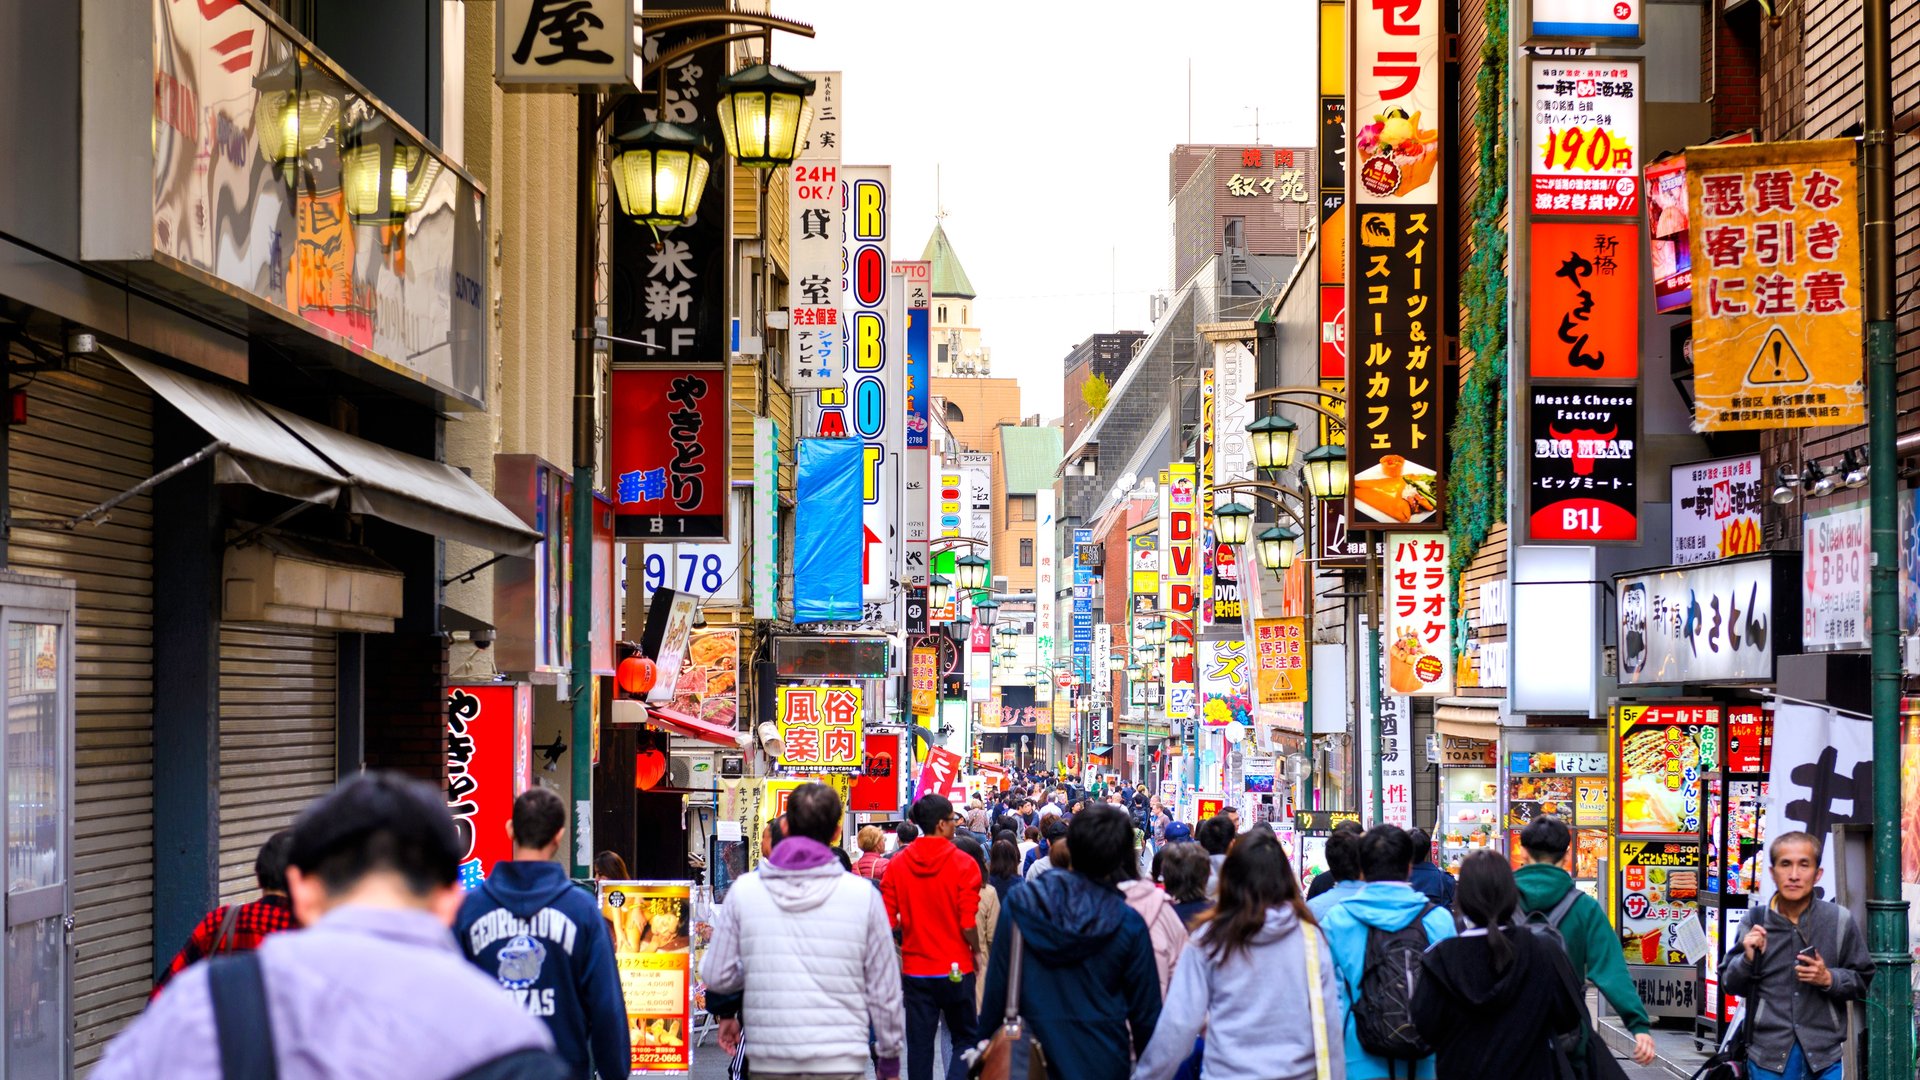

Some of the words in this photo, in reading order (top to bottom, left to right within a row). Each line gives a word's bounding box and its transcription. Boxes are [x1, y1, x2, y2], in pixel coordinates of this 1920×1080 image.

[1616, 6, 1629, 16] 3F
[511, 0, 615, 66] 屋
[1537, 79, 1633, 98] 一軒め酒場
[1242, 149, 1294, 168] 焼肉
[795, 166, 836, 182] 24H
[798, 186, 833, 200] OK!
[1227, 169, 1309, 202] 叙々苑
[1619, 182, 1632, 192] 2F
[1701, 168, 1842, 217] 悪質な
[1324, 197, 1342, 208] 4F
[1704, 219, 1841, 270] 客引き
[1593, 234, 1619, 276] 新橋
[1708, 270, 1848, 318] に注意
[794, 307, 837, 325] 完全個室
[1555, 251, 1604, 371] やきとん
[1405, 212, 1432, 449] スイーツ&ガレット
[641, 328, 696, 356] 1F
[854, 179, 886, 504] ROBOT
[1365, 254, 1392, 449] スコールカフェ
[798, 331, 812, 378] テレビ有
[817, 330, 832, 378] シャワー有
[1535, 395, 1569, 406] Meat
[1571, 395, 1581, 406] &
[1584, 395, 1633, 406] Cheese
[1557, 410, 1611, 422] Factory
[667, 374, 708, 511] やきとり
[1535, 440, 1573, 459] BIG
[1577, 440, 1633, 459] MEAT
[1562, 508, 1588, 530] B1
[1820, 522, 1844, 553] Steak
[1845, 515, 1862, 549] and
[912, 575, 925, 583] 2F
[1394, 540, 1418, 618] パセラ
[1422, 539, 1447, 643] カラオケ
[910, 608, 920, 616] 2F
[1684, 580, 1768, 659] やきとん
[907, 621, 926, 634] walk
[1259, 625, 1300, 639] 悪質な
[1805, 608, 1817, 638] B1
[1260, 641, 1300, 654] 客引き
[1261, 655, 1302, 670] に注意
[784, 690, 859, 726] 風俗
[1623, 709, 1638, 721] 5F
[1646, 709, 1719, 724] ゴールド館
[785, 728, 856, 763] 案内
[1445, 738, 1491, 750] ハニトー
[1445, 752, 1485, 761] TOAST
[1561, 757, 1601, 773] はしご
[1665, 726, 1681, 790] 食べ放題
[1579, 803, 1605, 811] Massage
[1683, 766, 1699, 831] もんじゃ
[1623, 844, 1638, 856] 4F
[1627, 896, 1698, 920] サムギョプ
[617, 958, 684, 969] リラクゼーション
